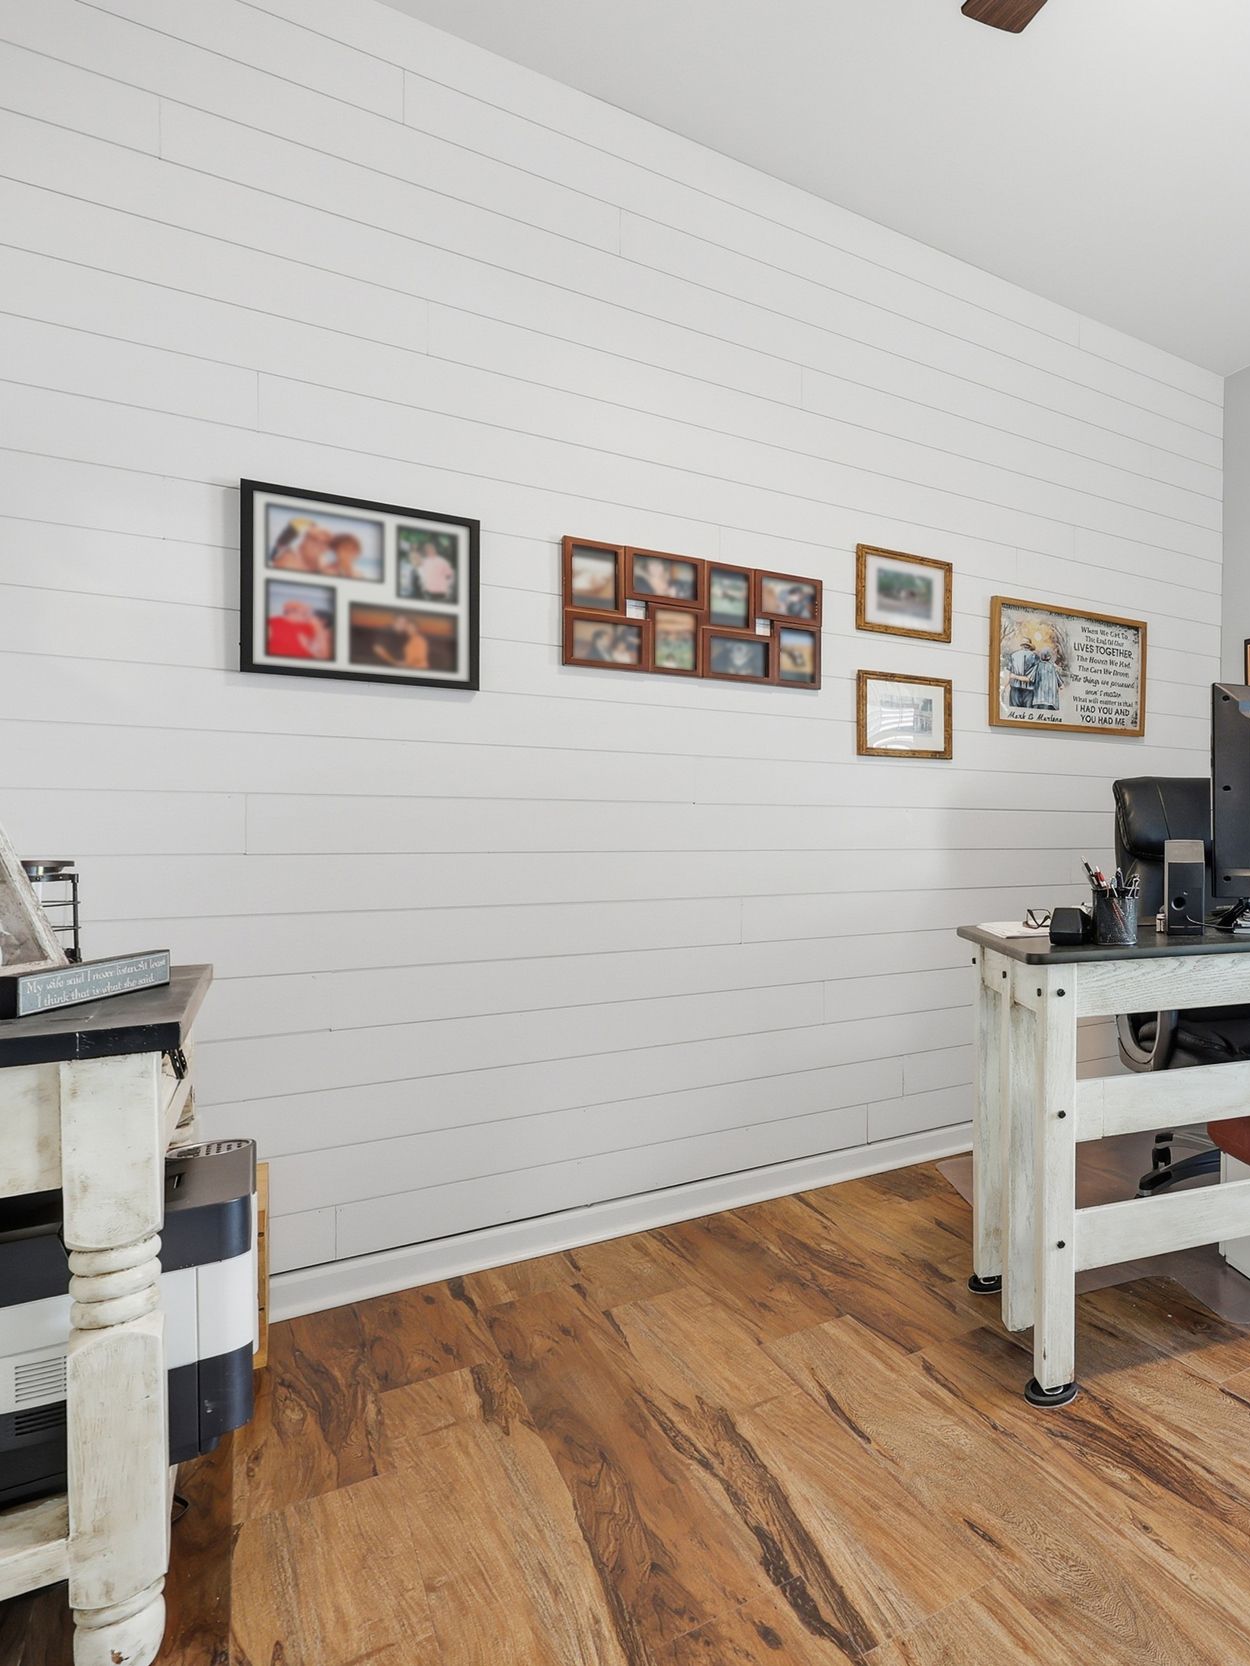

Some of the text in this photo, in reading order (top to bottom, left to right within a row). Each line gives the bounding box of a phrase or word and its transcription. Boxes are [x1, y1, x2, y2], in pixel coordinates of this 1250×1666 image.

[1073, 642, 1134, 660] LIVES TOGETHER,
[1080, 704, 1096, 714] HAD
[1097, 706, 1113, 715] YOU
[1114, 708, 1130, 717] AND
[1080, 714, 1126, 726] YOU HAD ME
[26, 981, 43, 996] My
[47, 976, 64, 989] wife
[87, 969, 91, 982] I
[37, 994, 42, 1008] I
[44, 990, 70, 1007] think
[71, 987, 90, 1000] that
[102, 981, 122, 993] what
[124, 977, 136, 988] she
